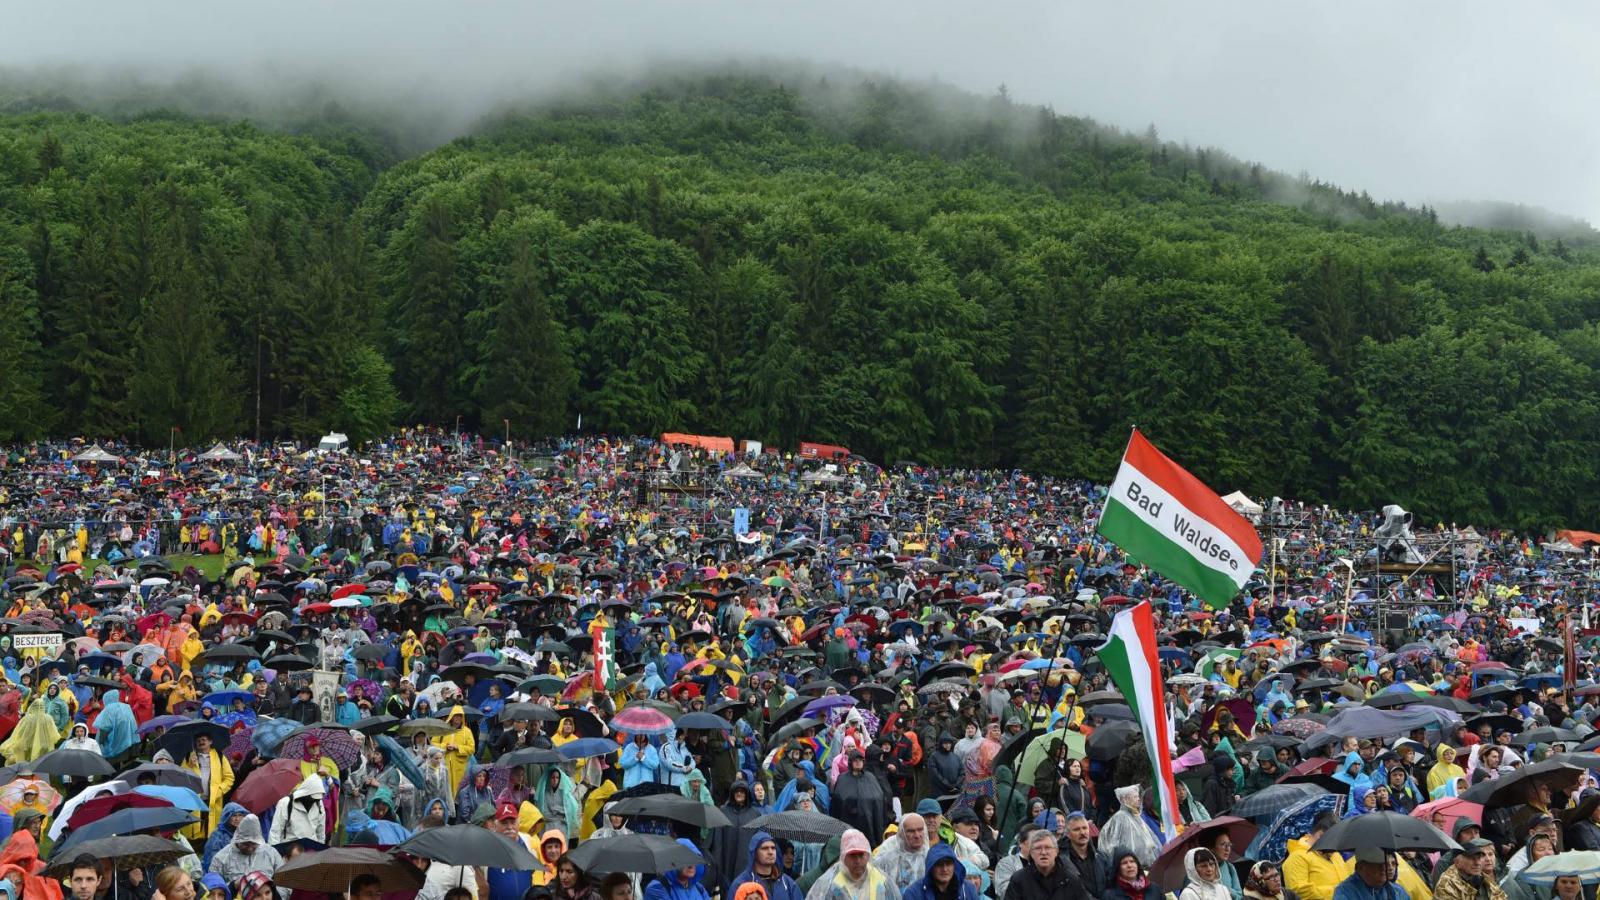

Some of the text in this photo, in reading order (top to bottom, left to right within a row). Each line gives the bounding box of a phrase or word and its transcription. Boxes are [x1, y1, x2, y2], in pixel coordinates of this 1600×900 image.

[1127, 481, 1238, 571] Bad Waldsee
[15, 636, 60, 646] BESZTERCE
